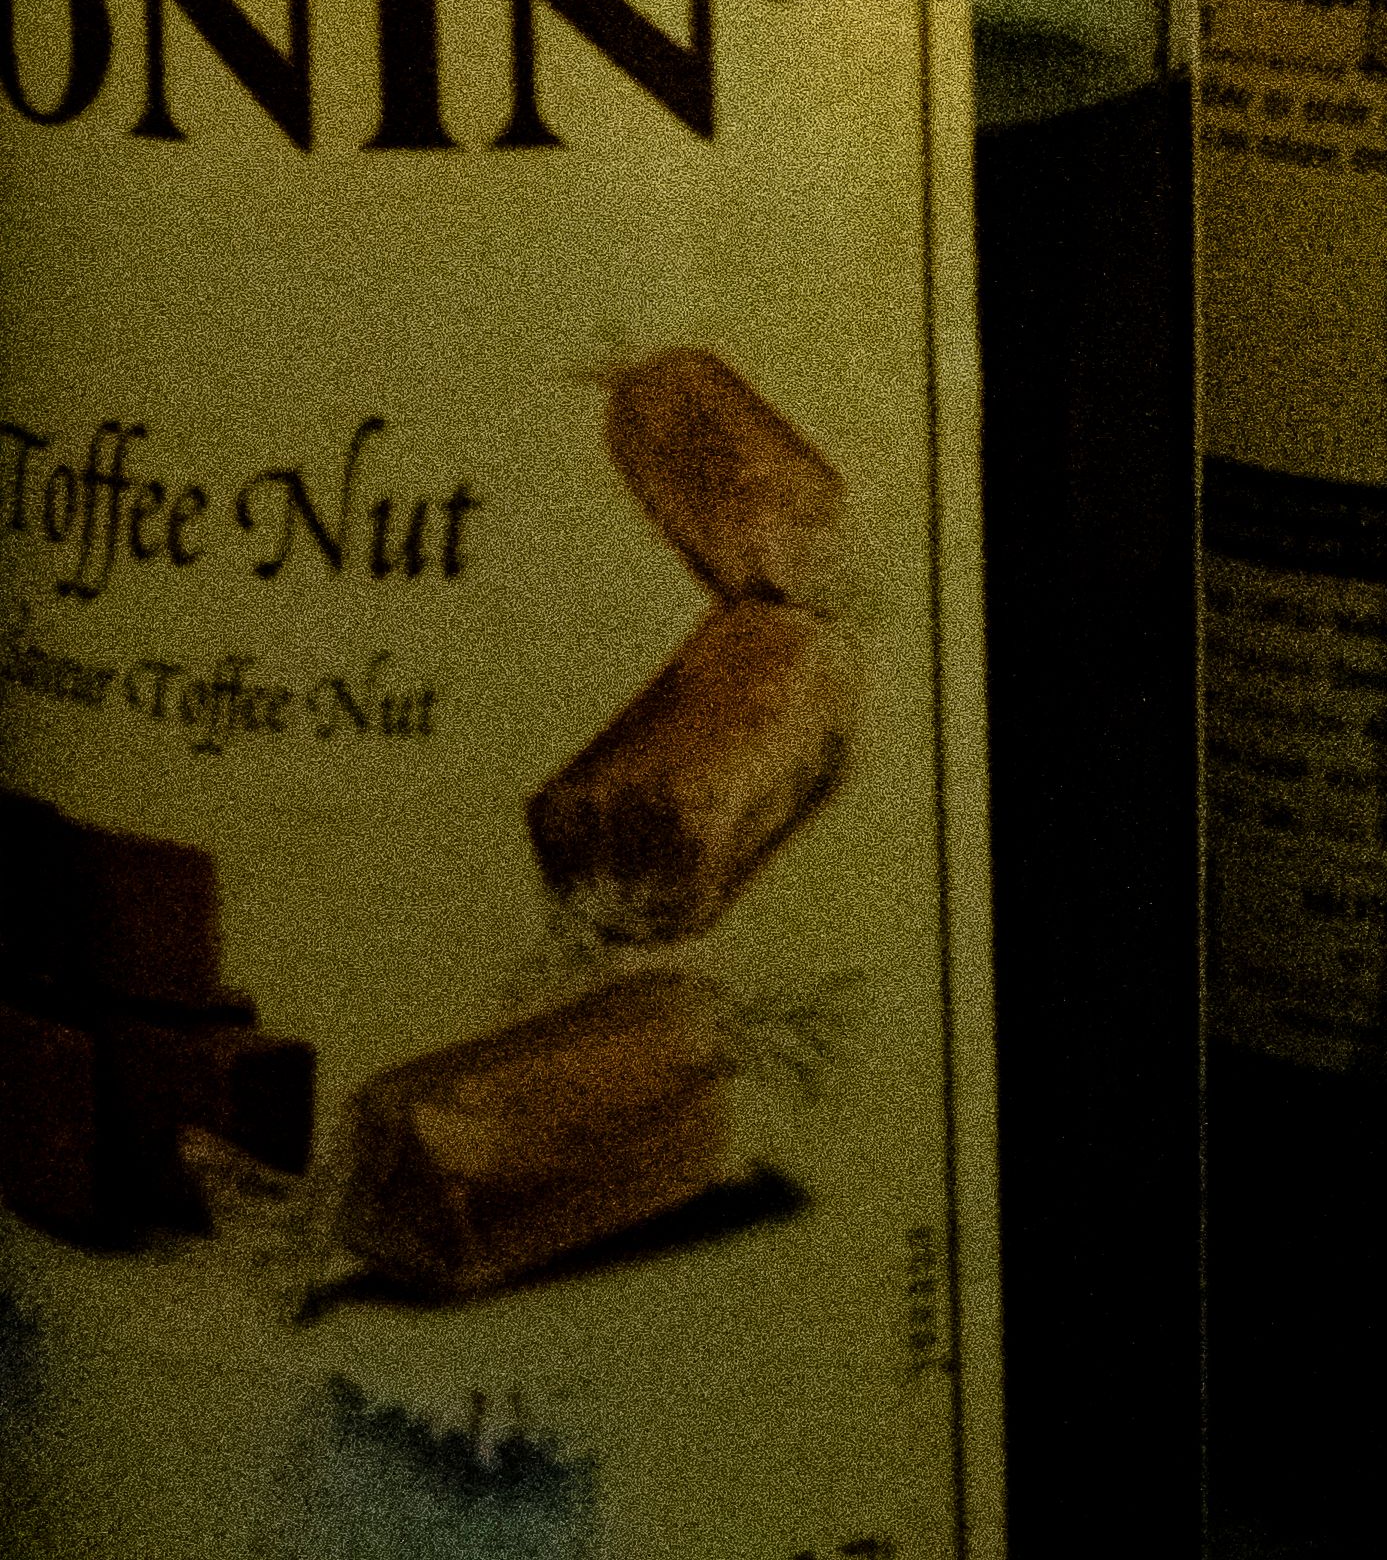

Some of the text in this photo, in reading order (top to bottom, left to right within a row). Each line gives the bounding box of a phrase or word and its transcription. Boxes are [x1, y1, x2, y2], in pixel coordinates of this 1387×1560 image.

[0, 413, 484, 602] Toffee Nut
[122, 649, 437, 757] Toffee Nut
